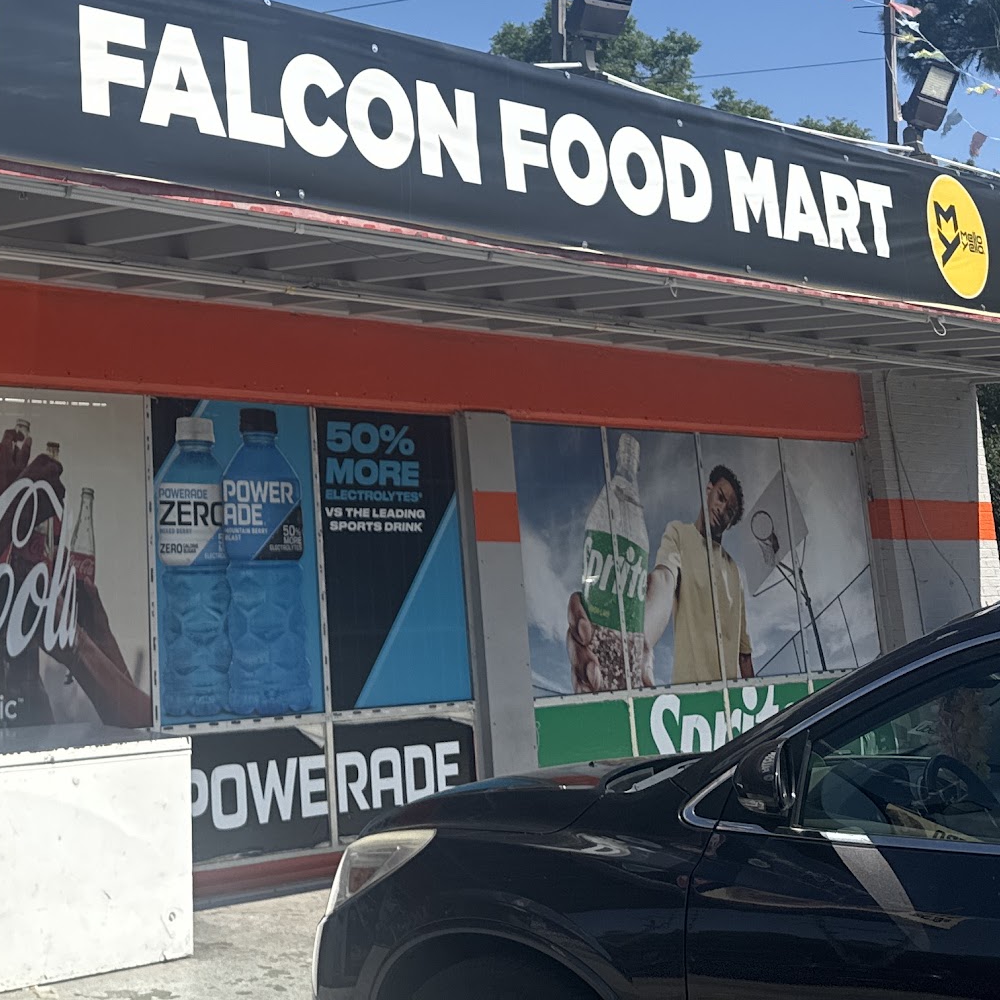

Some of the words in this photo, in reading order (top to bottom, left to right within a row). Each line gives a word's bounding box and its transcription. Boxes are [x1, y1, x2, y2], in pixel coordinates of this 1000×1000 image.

[79, 4, 482, 185] FALCON
[499, 99, 713, 224] FOOD
[724, 149, 893, 259] MART
[326, 421, 415, 456] 50%
[325, 457, 420, 487] MORE
[158, 487, 209, 500] POWERADE
[223, 479, 294, 504] POWER
[159, 500, 223, 527] ZERO
[223, 502, 264, 526] ADE
[325, 506, 343, 518] VS
[345, 507, 370, 518] THE
[372, 508, 426, 519] LEADING
[329, 520, 383, 532] SPORTS
[384, 521, 423, 532] DRINK
[160, 543, 183, 554] ZERO
[650, 685, 796, 756] Sprit
